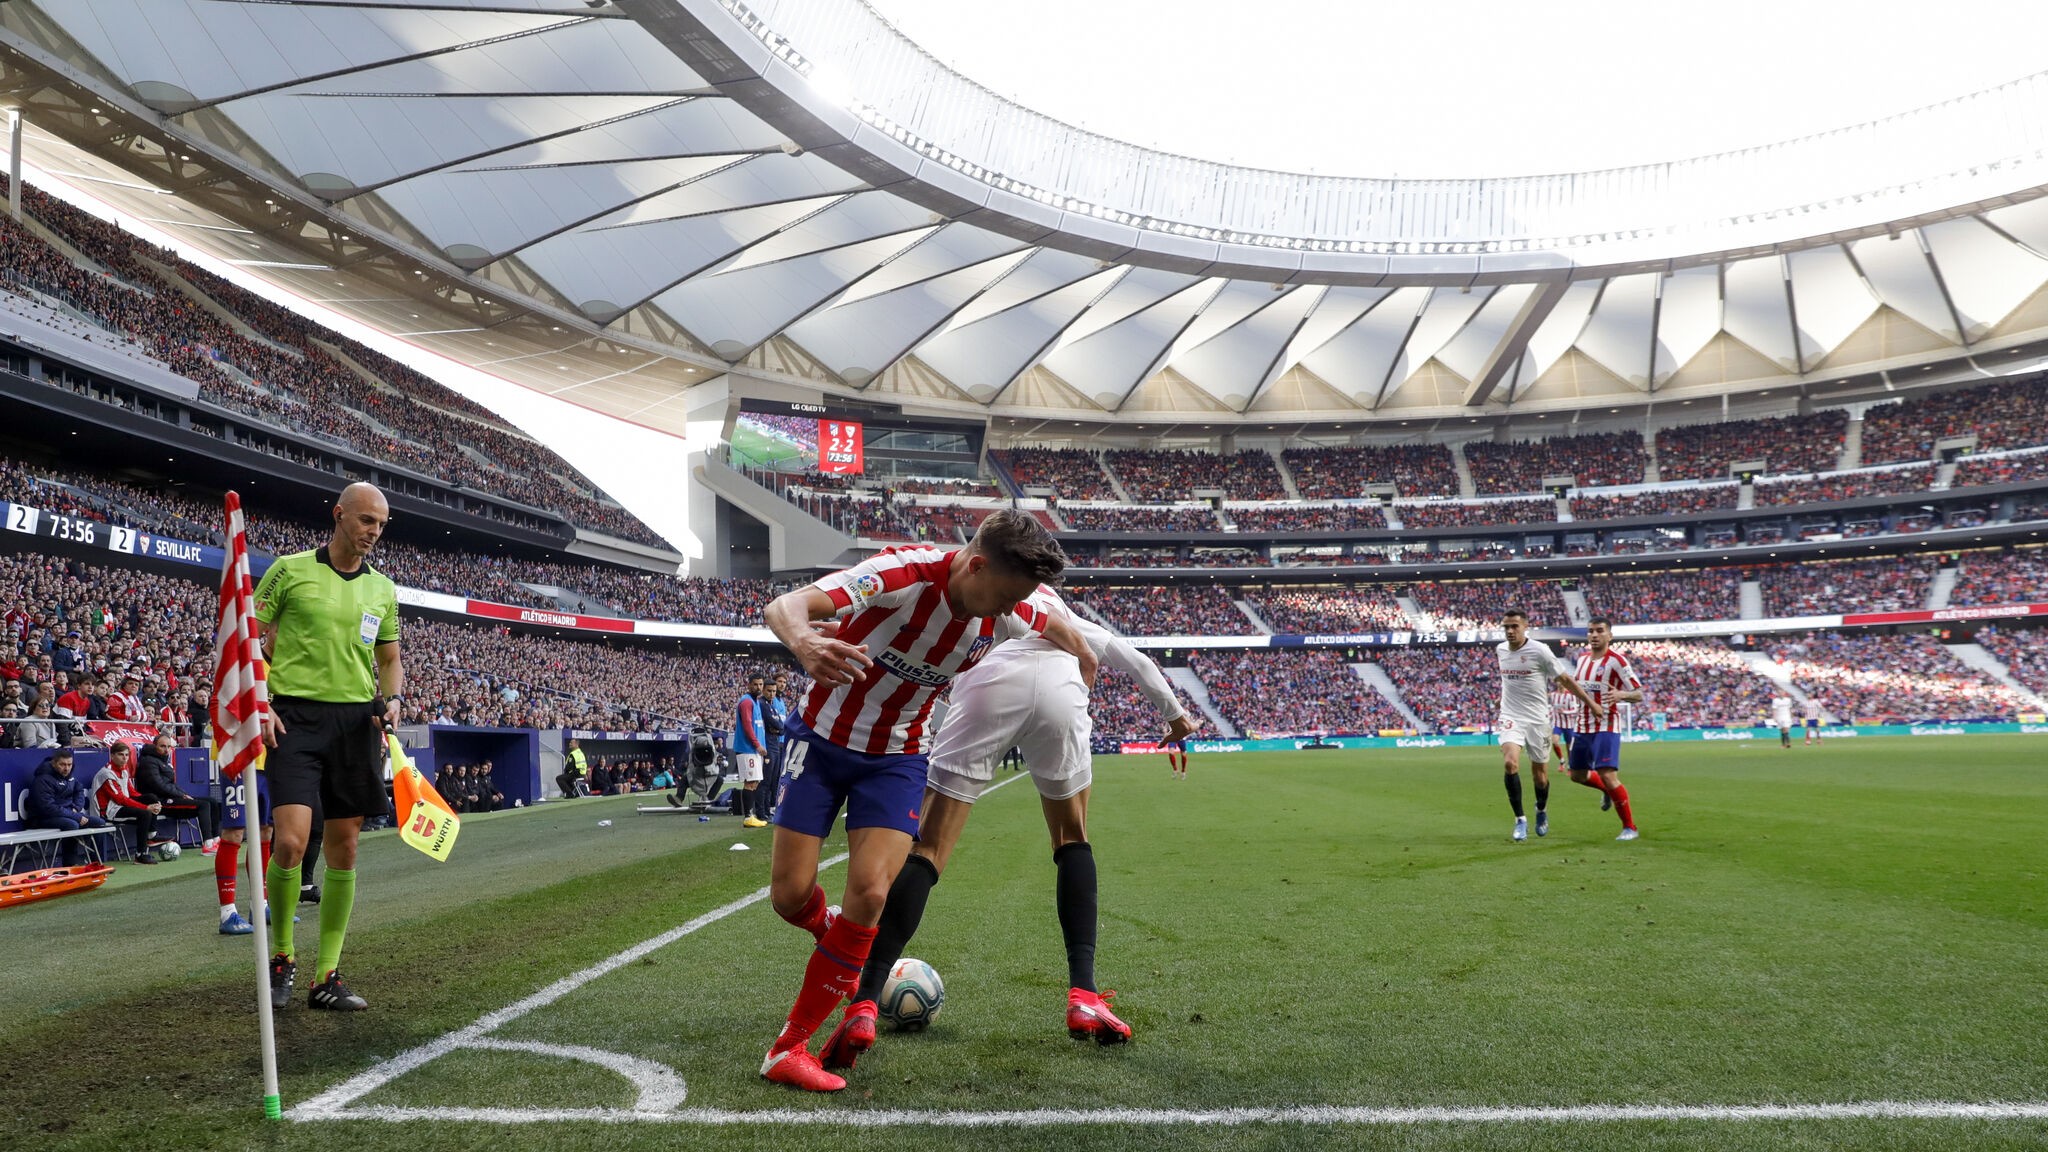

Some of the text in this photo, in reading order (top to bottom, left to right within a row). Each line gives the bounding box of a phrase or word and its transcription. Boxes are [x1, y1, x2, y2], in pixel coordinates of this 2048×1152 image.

[801, 404, 817, 412] OLED
[829, 438, 854, 452] 2 2
[829, 452, 853, 463] 73:56
[16, 506, 202, 563] 2 73:56 2 SEVILLA FC
[847, 582, 863, 603] LaLiga
[520, 610, 548, 623] ATLÉTICO
[553, 614, 577, 626] MADRID
[1989, 605, 2031, 617] MADRID
[363, 614, 378, 626] FIFA
[1303, 634, 1336, 645] ATLÉTICO
[1346, 635, 1374, 644] MADRID
[1416, 632, 1448, 643] 73:56
[748, 758, 755, 769] 8
[780, 738, 810, 781] 14
[225, 784, 246, 806] 20
[432, 817, 453, 852] WÜRTH
